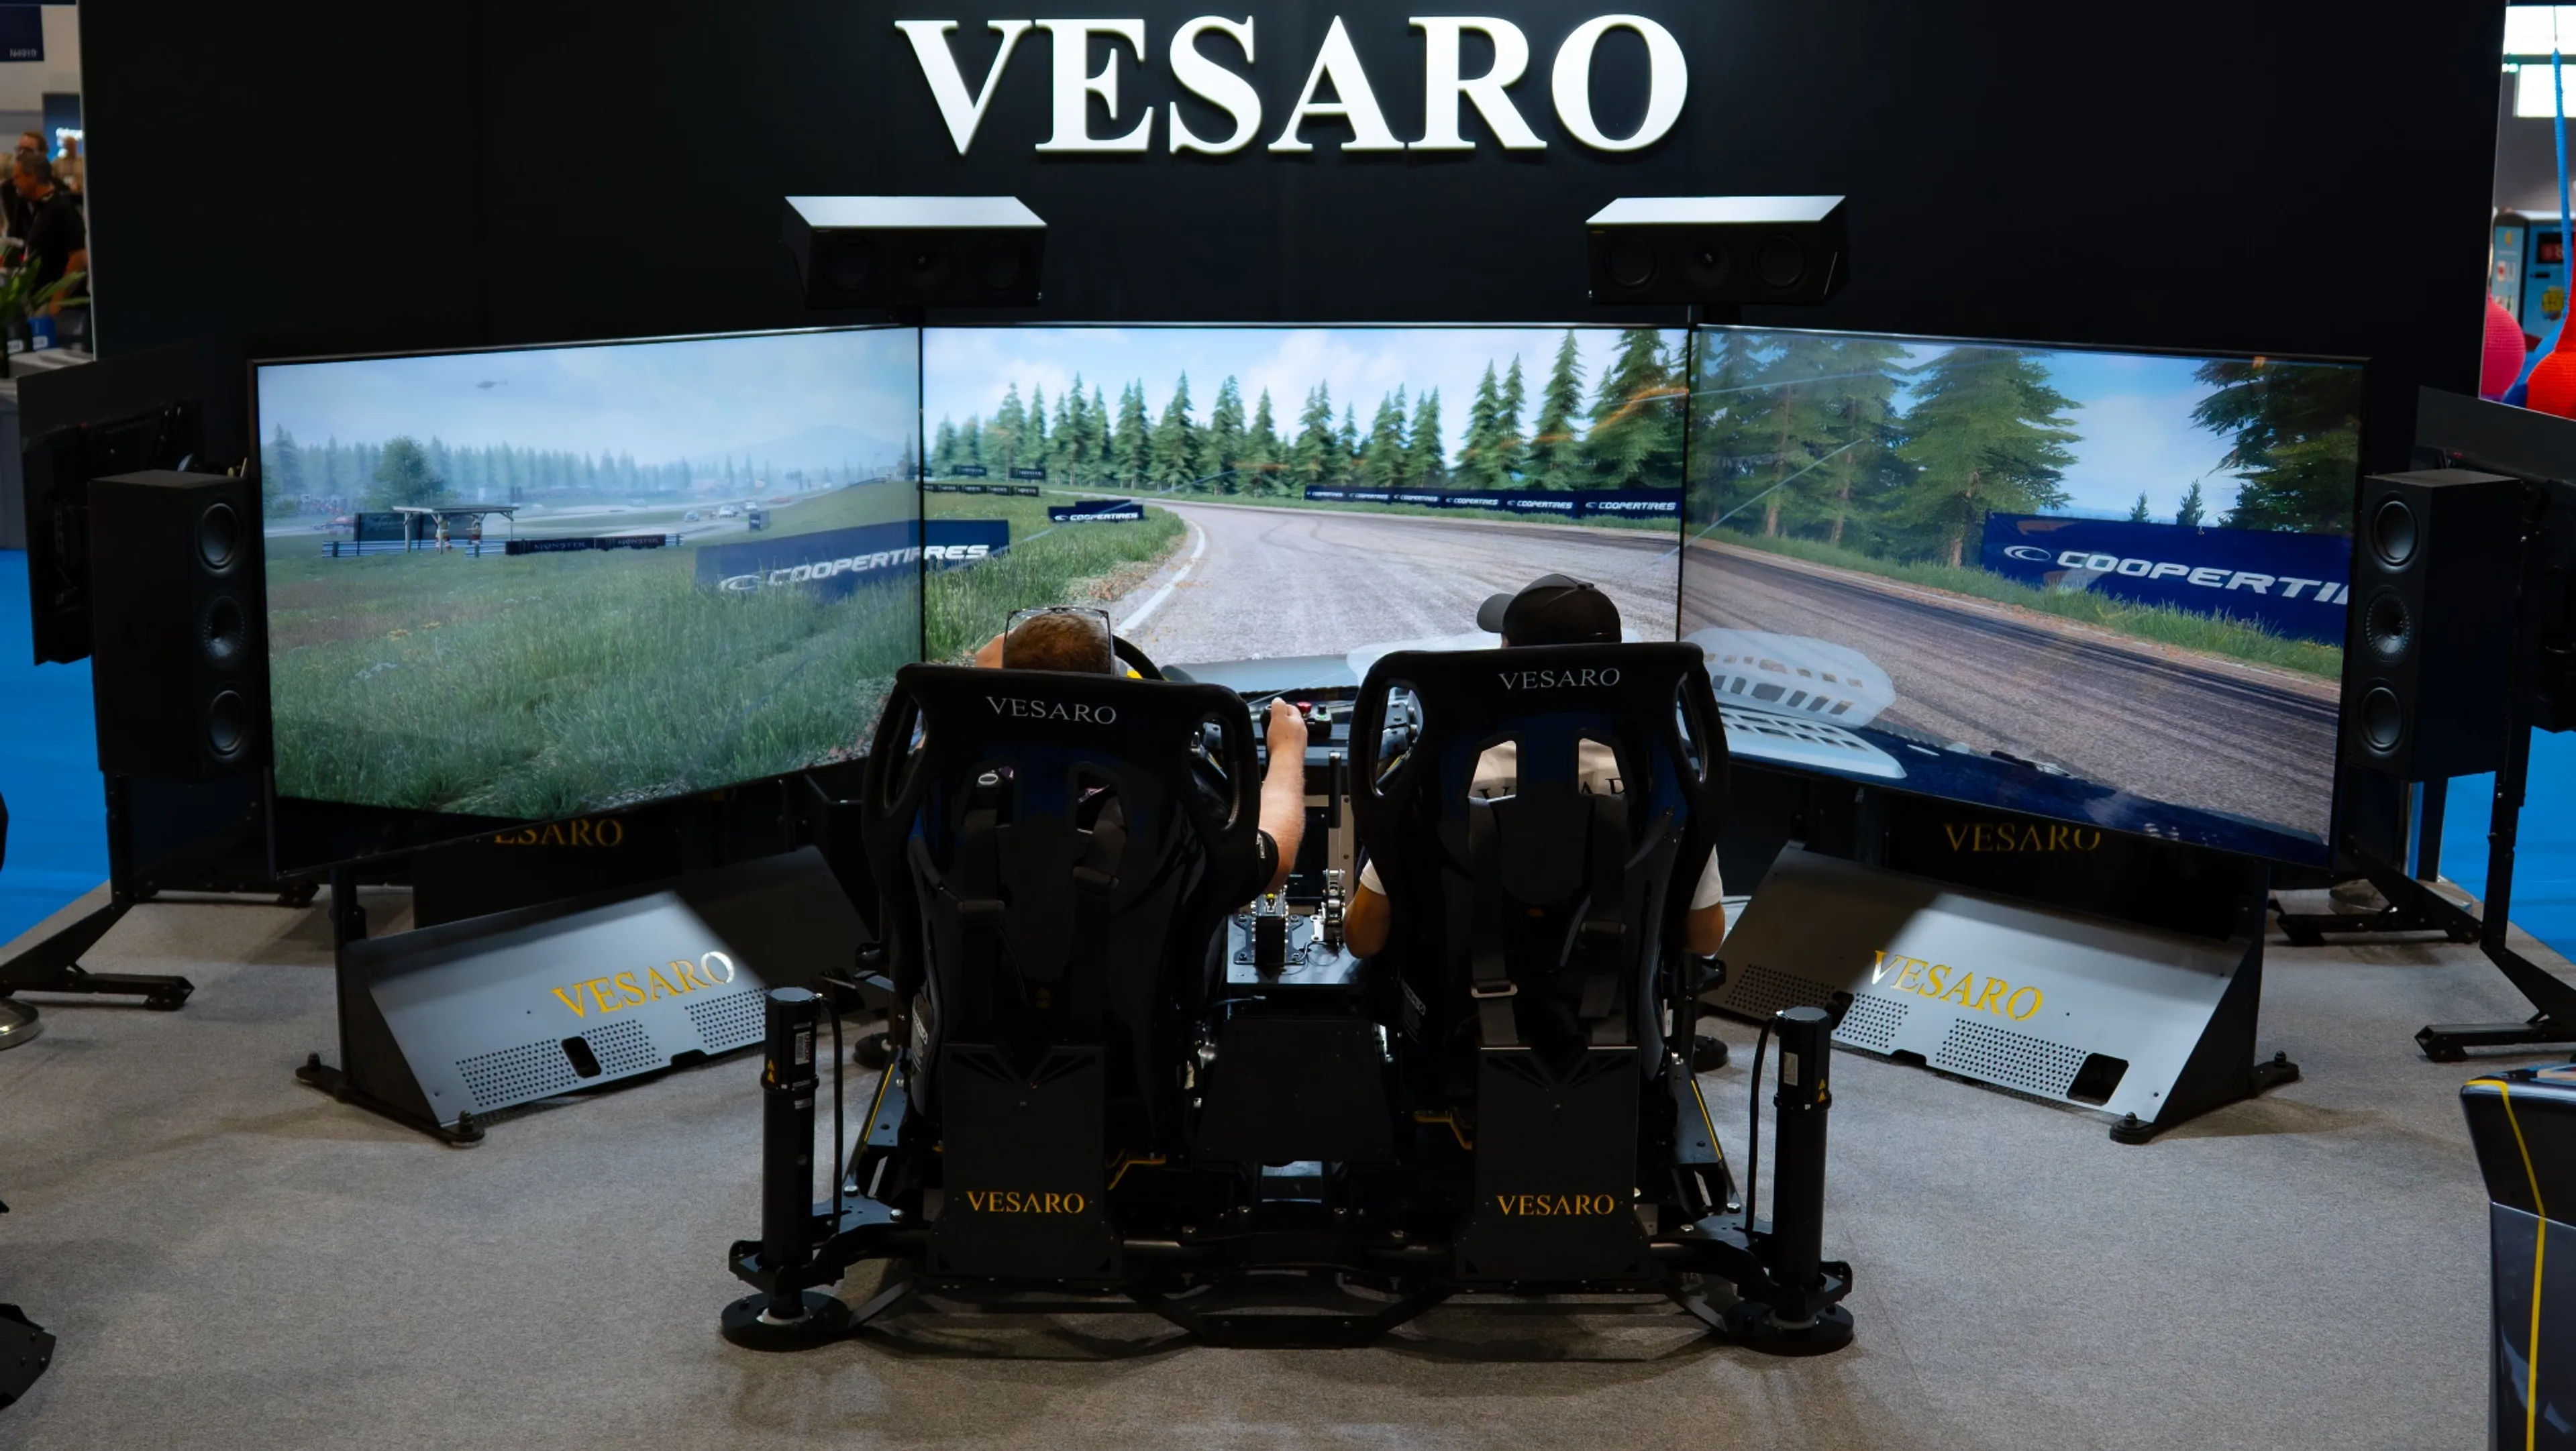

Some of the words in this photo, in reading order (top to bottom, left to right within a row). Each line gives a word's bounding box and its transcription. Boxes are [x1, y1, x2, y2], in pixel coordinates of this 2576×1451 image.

[894, 15, 1688, 156] VESARO
[1400, 494, 1439, 502] COOPERTIRES
[1453, 496, 1499, 505] COOPERTIRES
[1516, 500, 1574, 509] COOPERTIRES
[1598, 501, 1676, 510] COOPERTIRES
[1070, 512, 1139, 521] COOPERTIRES
[1498, 667, 1620, 691] VESARO
[985, 696, 1117, 725] VESARO
[1944, 822, 2101, 852] VESARO
[550, 951, 735, 1019] VESARO
[1871, 950, 2043, 1021] VESARO
[966, 1190, 1085, 1214] VESARO
[1496, 1194, 1615, 1216] VESARO
